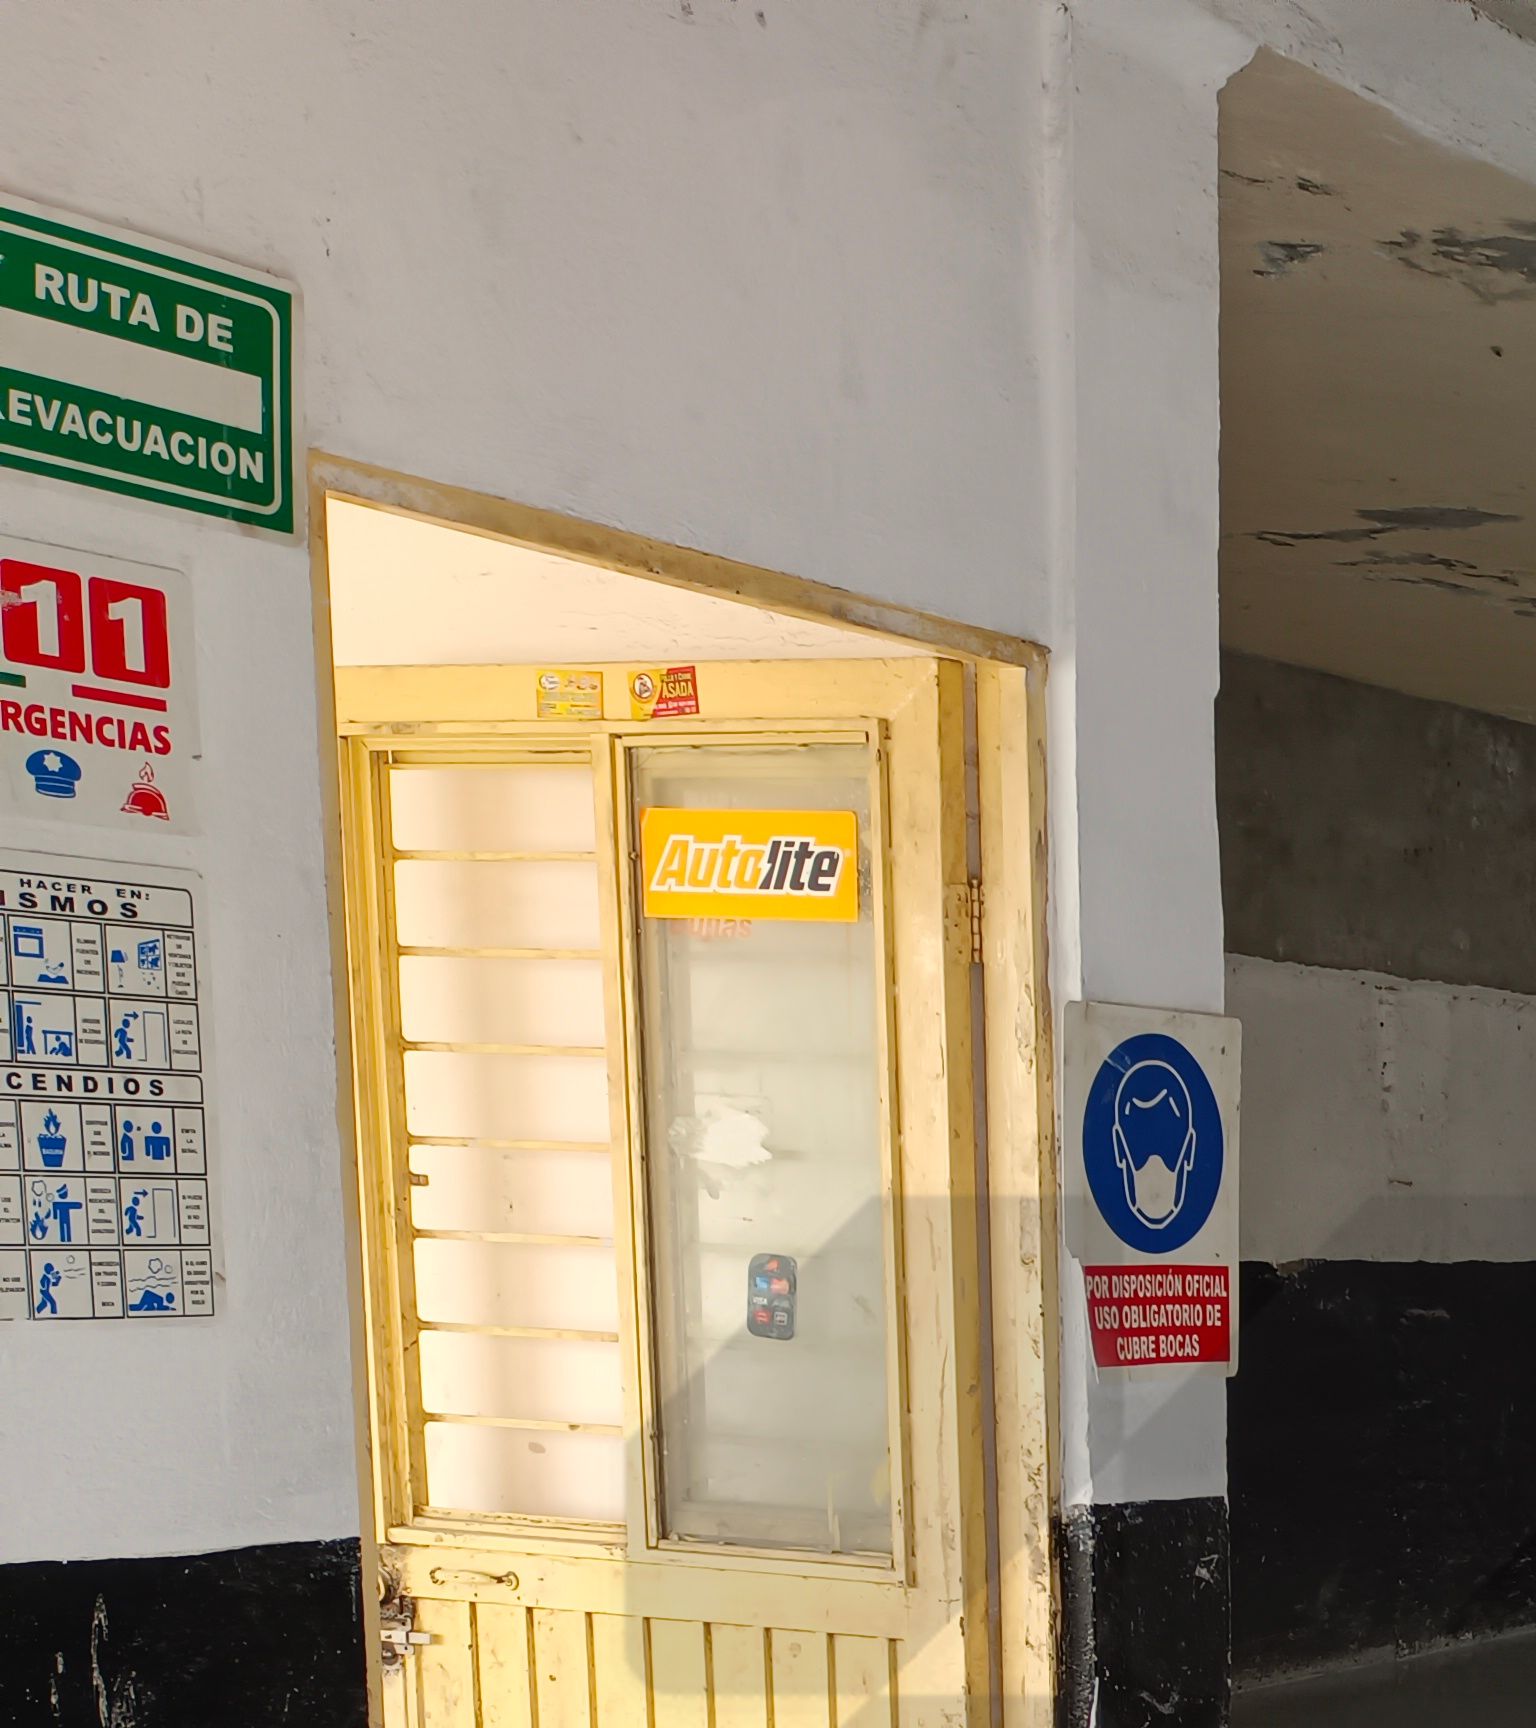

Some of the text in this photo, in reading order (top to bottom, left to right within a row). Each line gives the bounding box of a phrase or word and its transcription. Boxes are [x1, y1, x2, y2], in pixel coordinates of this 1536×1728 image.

[34, 263, 234, 352] RUTA DE
[8, 388, 264, 483] EVACUACION
[653, 837, 841, 893] Autolite
[19, 878, 150, 900] HACER EN:
[6, 1072, 164, 1096] CENDIOS
[1086, 1269, 1228, 1299] POR DISPOSICIÓN OFICIAL
[1095, 1304, 1222, 1329] USO OBLIGATORIO DE
[1117, 1334, 1200, 1360] CUBRE BOCAS
